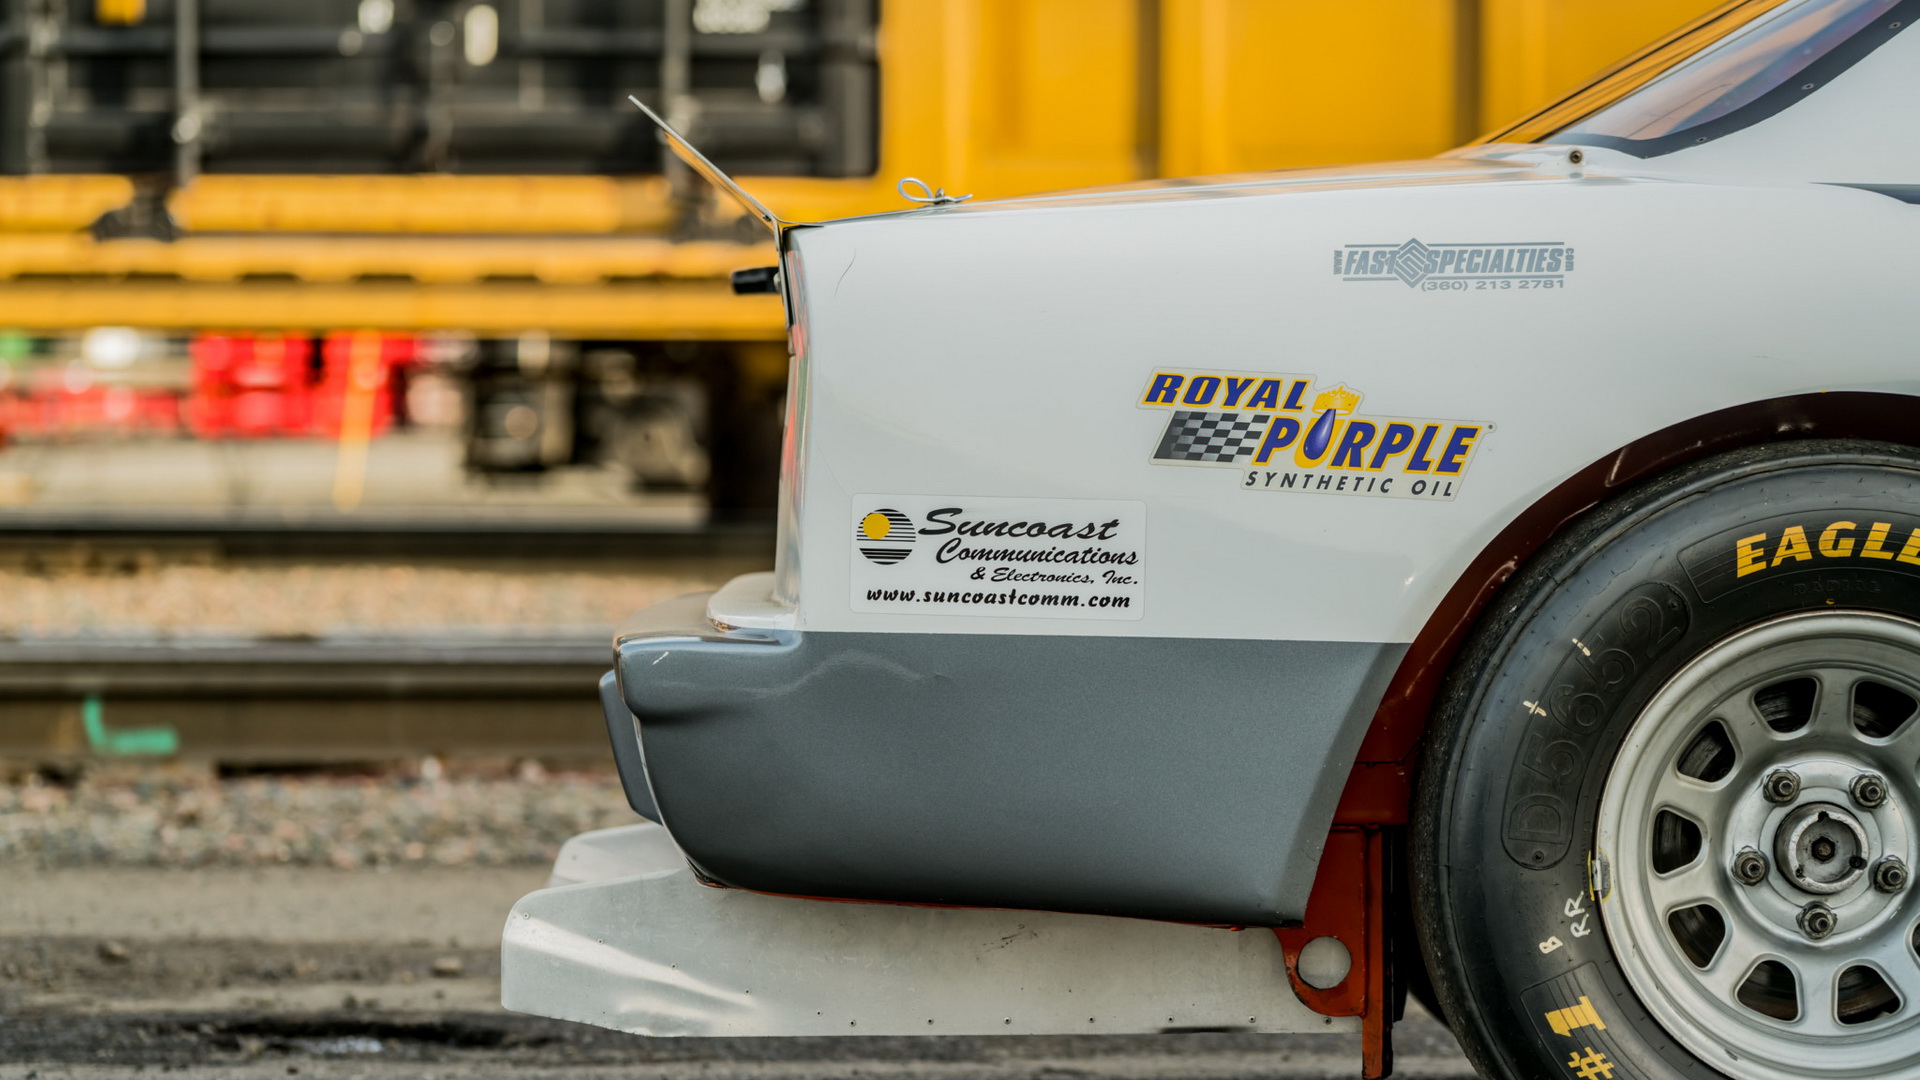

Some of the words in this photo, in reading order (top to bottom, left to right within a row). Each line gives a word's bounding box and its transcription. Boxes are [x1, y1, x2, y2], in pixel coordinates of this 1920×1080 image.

[1343, 250, 1401, 275] FAST
[1423, 248, 1564, 274] SPECIALTIES
[1421, 280, 1468, 291] (360)
[1475, 280, 1511, 290] 213
[1518, 279, 1564, 289] 2781
[1142, 373, 1310, 412] ROYAL
[1252, 413, 1482, 475] PURPLE
[1245, 471, 1393, 493] SYNTHETIC
[1411, 480, 1452, 497] OIL
[918, 508, 1119, 540] Suncoast
[936, 538, 1138, 565] Communications
[970, 567, 985, 580] &
[991, 568, 1095, 584] Electronics,
[1102, 570, 1138, 584] Inc.
[866, 589, 1130, 608] www.suncoastcomm.com
[1508, 596, 1681, 846] D5652
[1544, 996, 1614, 1080] #1
